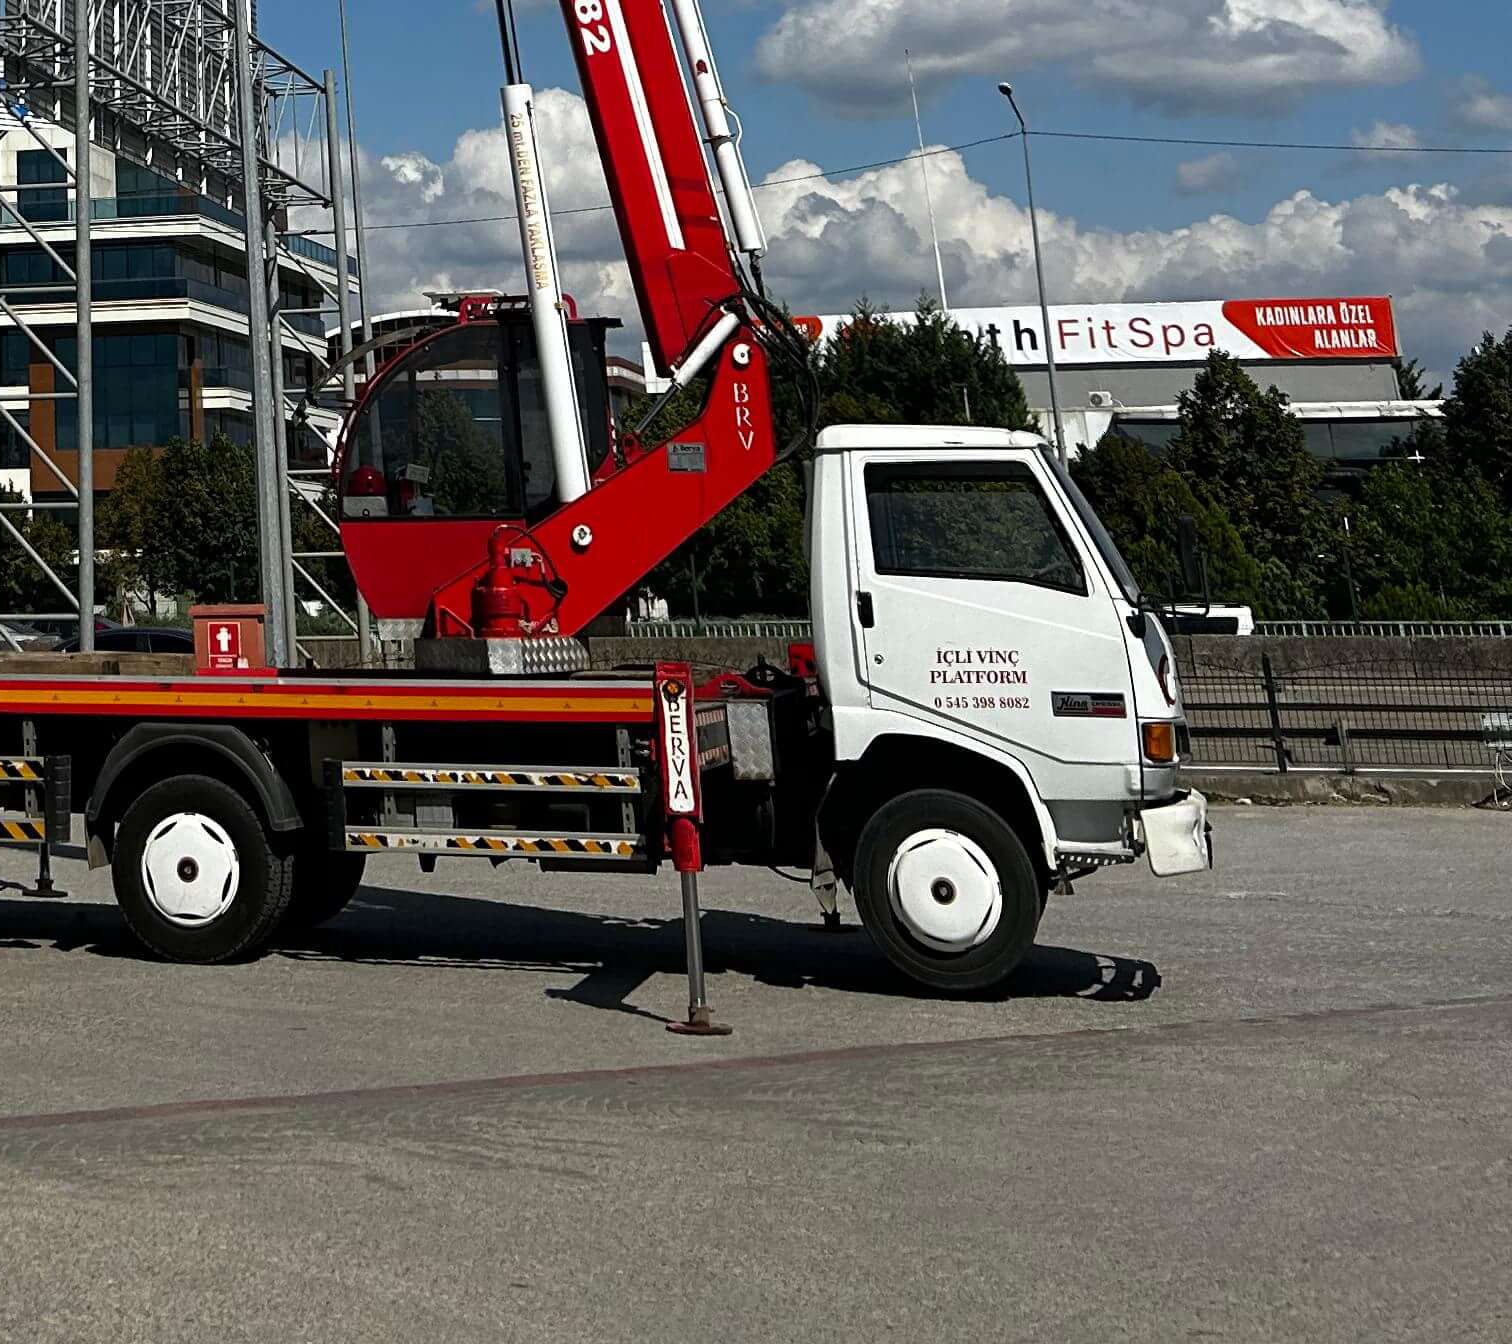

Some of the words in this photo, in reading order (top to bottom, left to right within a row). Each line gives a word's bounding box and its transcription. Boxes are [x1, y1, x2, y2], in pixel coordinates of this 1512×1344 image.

[1255, 306, 1337, 327] KADINLARA
[1339, 302, 1375, 325] ÖZEL
[1314, 327, 1377, 350] ALANLAR
[936, 647, 973, 667] İÇLİ
[975, 647, 1020, 667] VİNÇ
[930, 670, 1028, 684] PLATFORM
[934, 696, 943, 709] 0
[946, 696, 970, 709] 545
[972, 696, 996, 709] 398
[999, 696, 1031, 709] 8082
